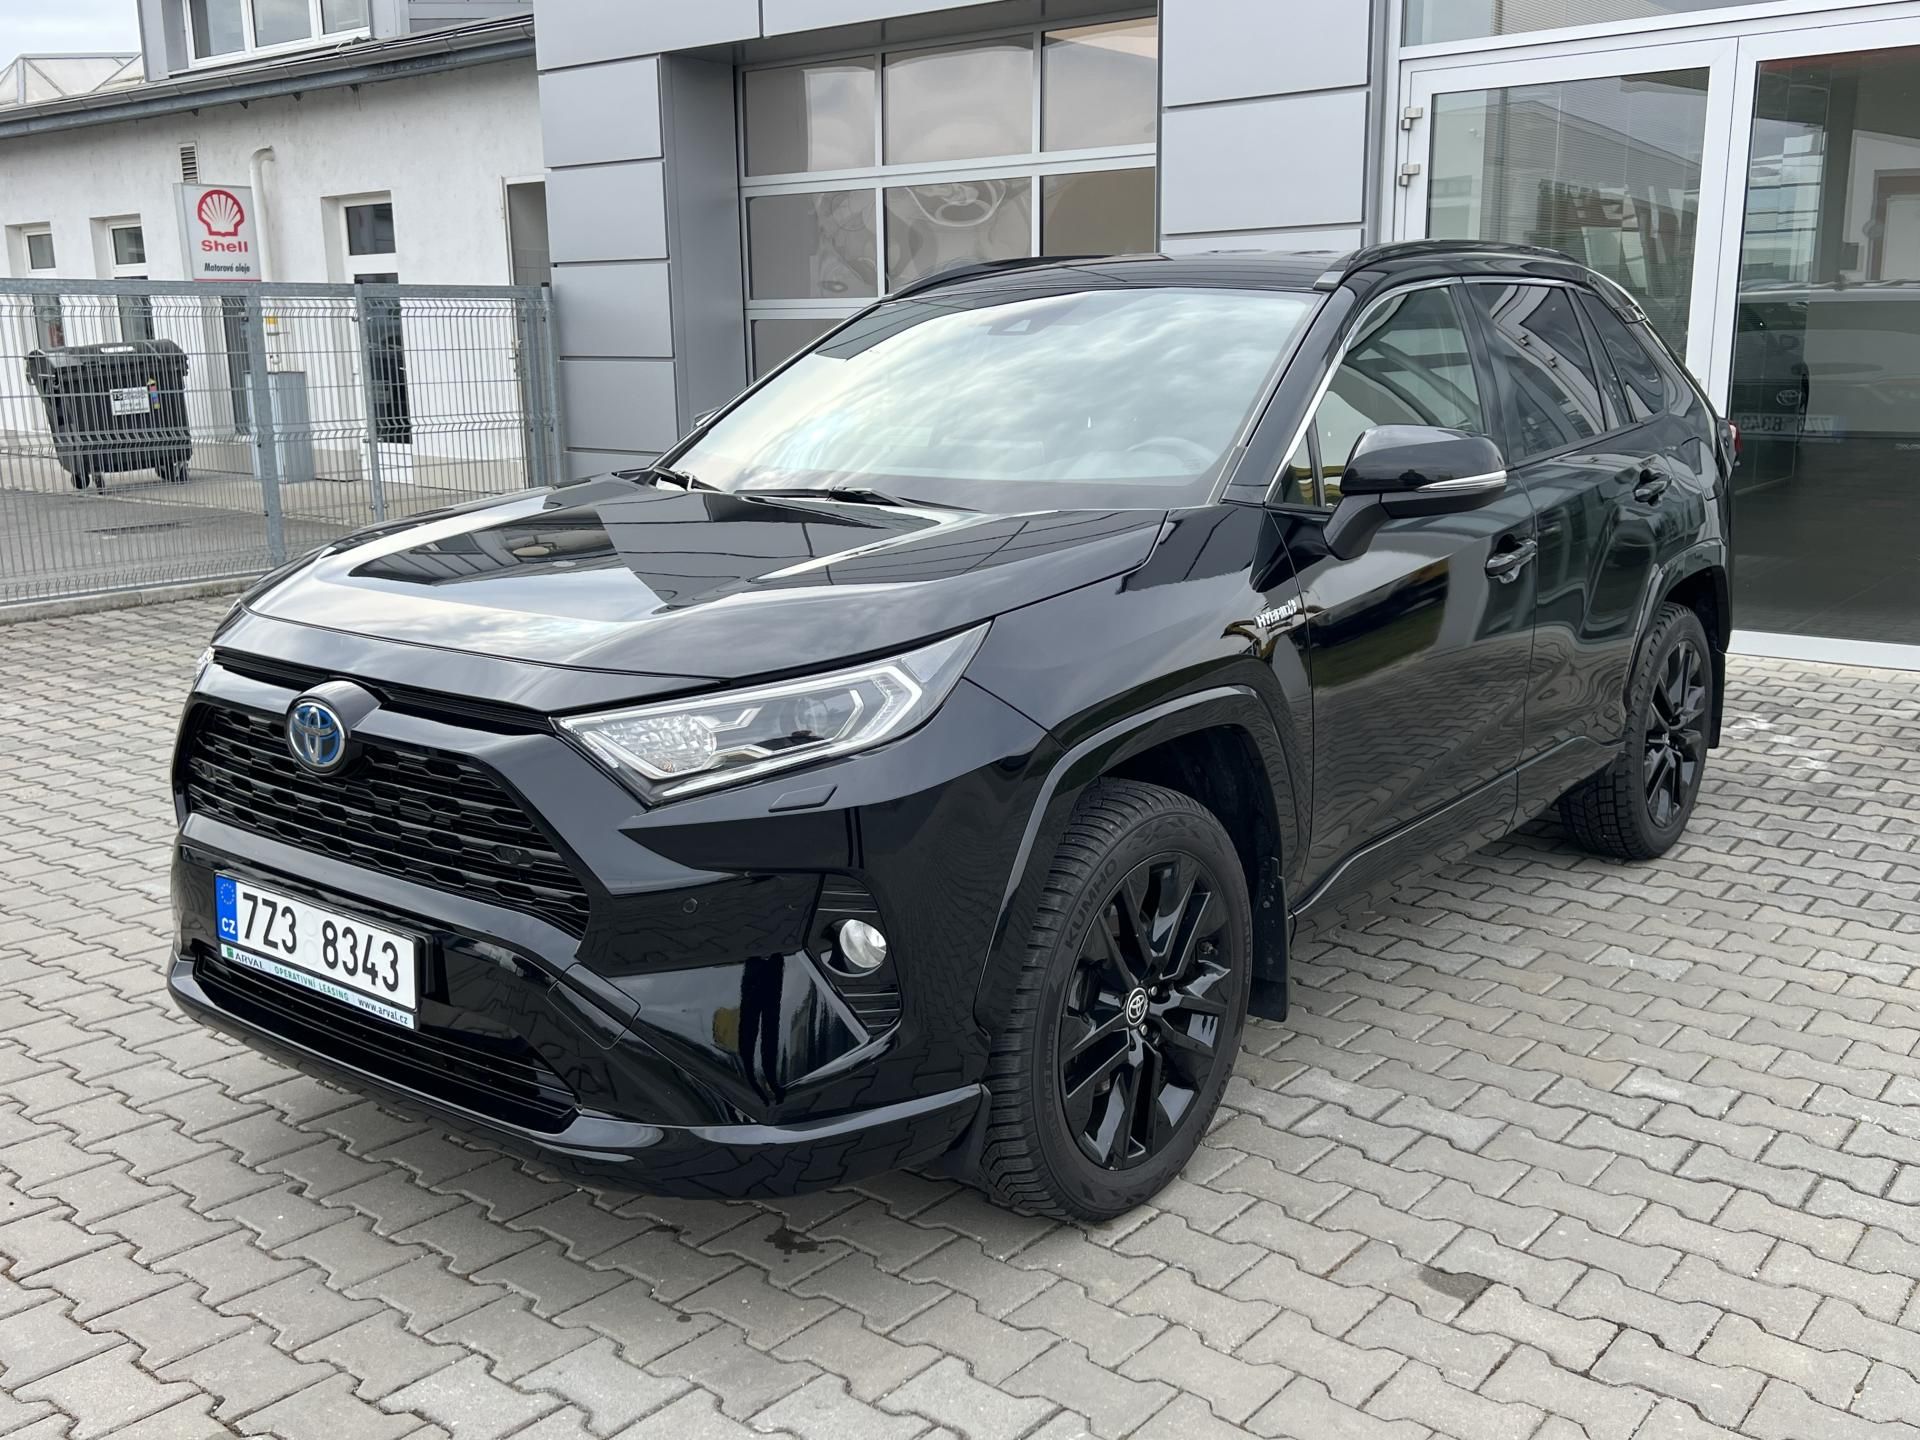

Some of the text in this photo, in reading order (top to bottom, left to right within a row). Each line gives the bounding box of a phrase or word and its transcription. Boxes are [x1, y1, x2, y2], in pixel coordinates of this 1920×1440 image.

[201, 240, 248, 252] Shell
[204, 262, 251, 274] Motorové oleje
[1255, 604, 1291, 628] HYBRID
[1065, 859, 1117, 949] KUMHO
[221, 917, 236, 934] CZ
[242, 892, 399, 992] 7Z3 8343
[235, 953, 264, 969] ARVAL
[274, 966, 349, 1001] OPERATIVNÍ LEASING
[358, 998, 408, 1025] www.arval.cz
